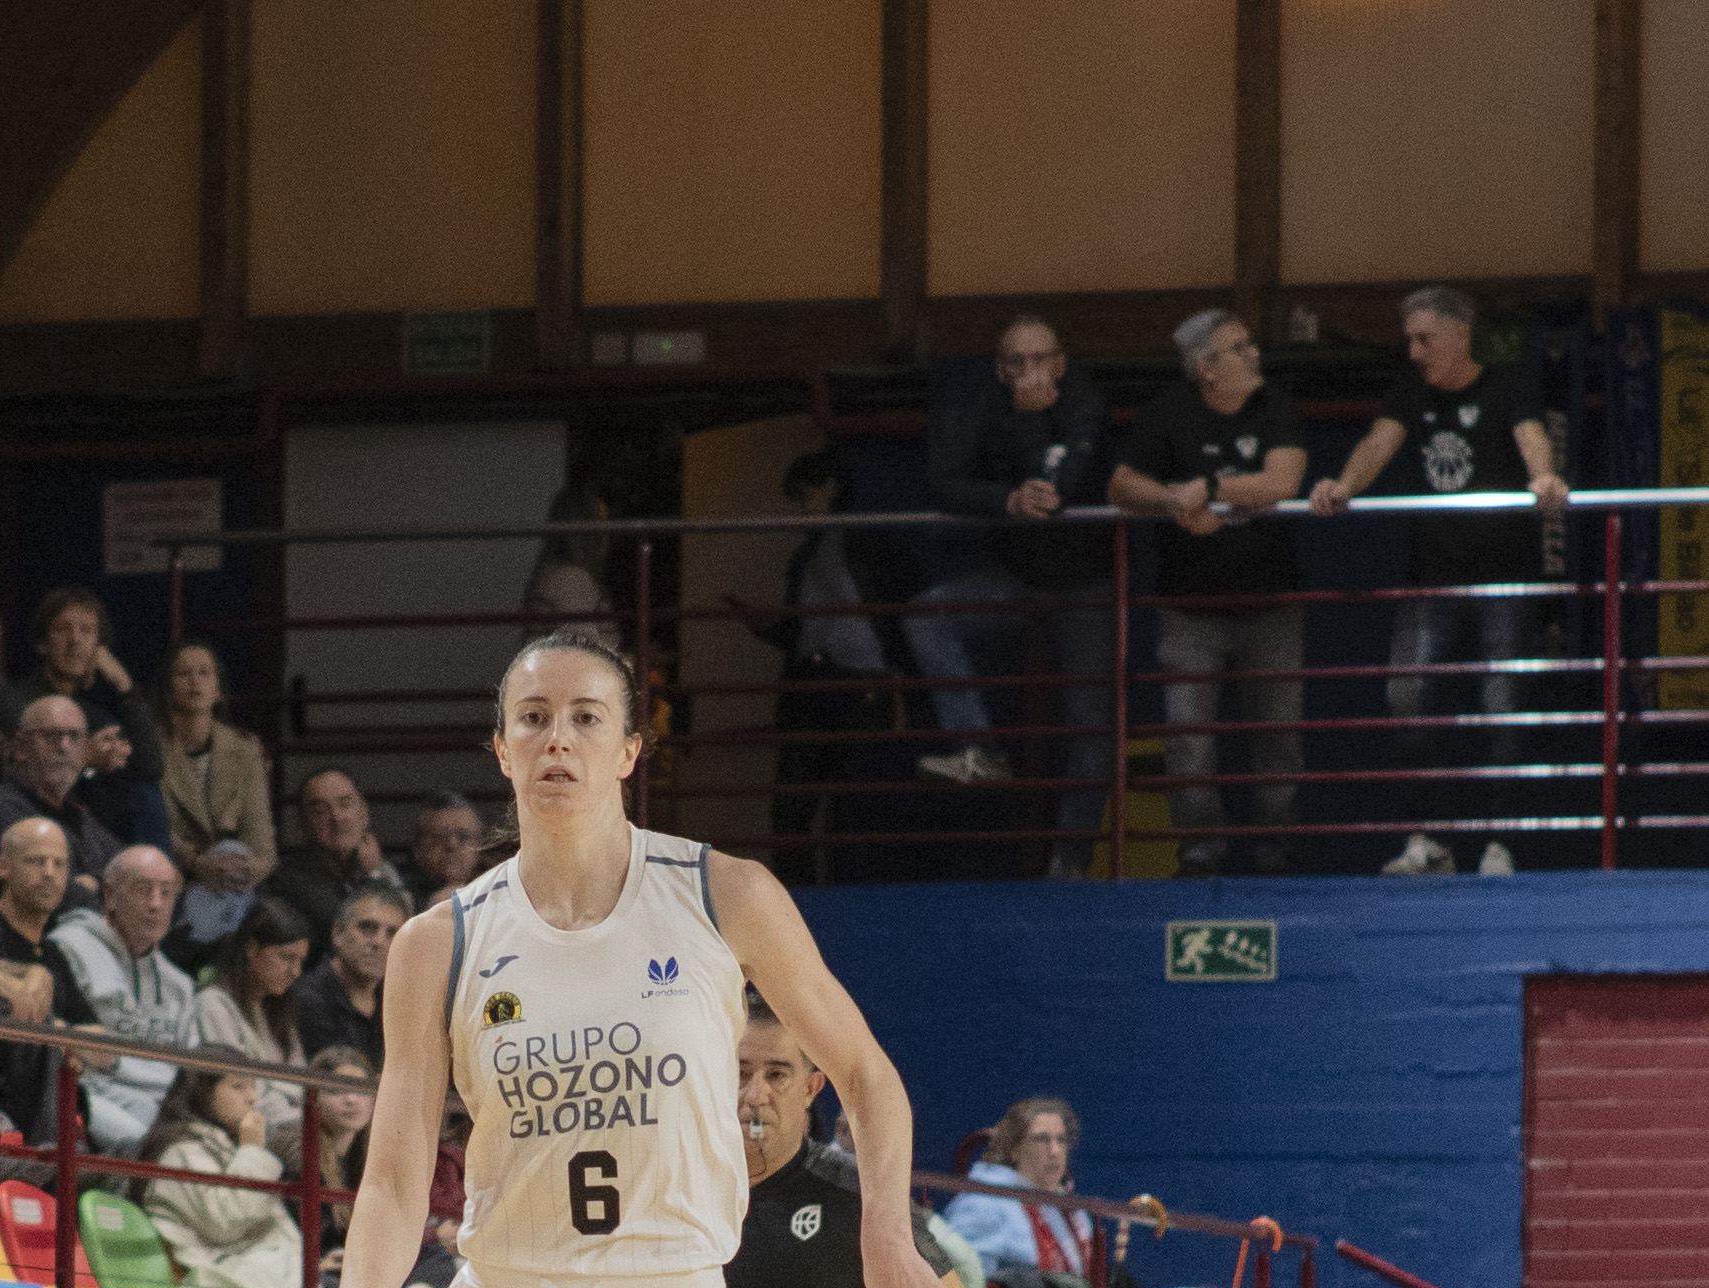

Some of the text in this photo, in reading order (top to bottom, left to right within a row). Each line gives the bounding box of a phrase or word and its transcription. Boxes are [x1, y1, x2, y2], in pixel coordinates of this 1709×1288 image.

[493, 1021, 642, 1075] GRUPO
[497, 1052, 687, 1108] HOZONO
[509, 1092, 659, 1139] GLOBAL
[567, 1149, 621, 1236] 6
